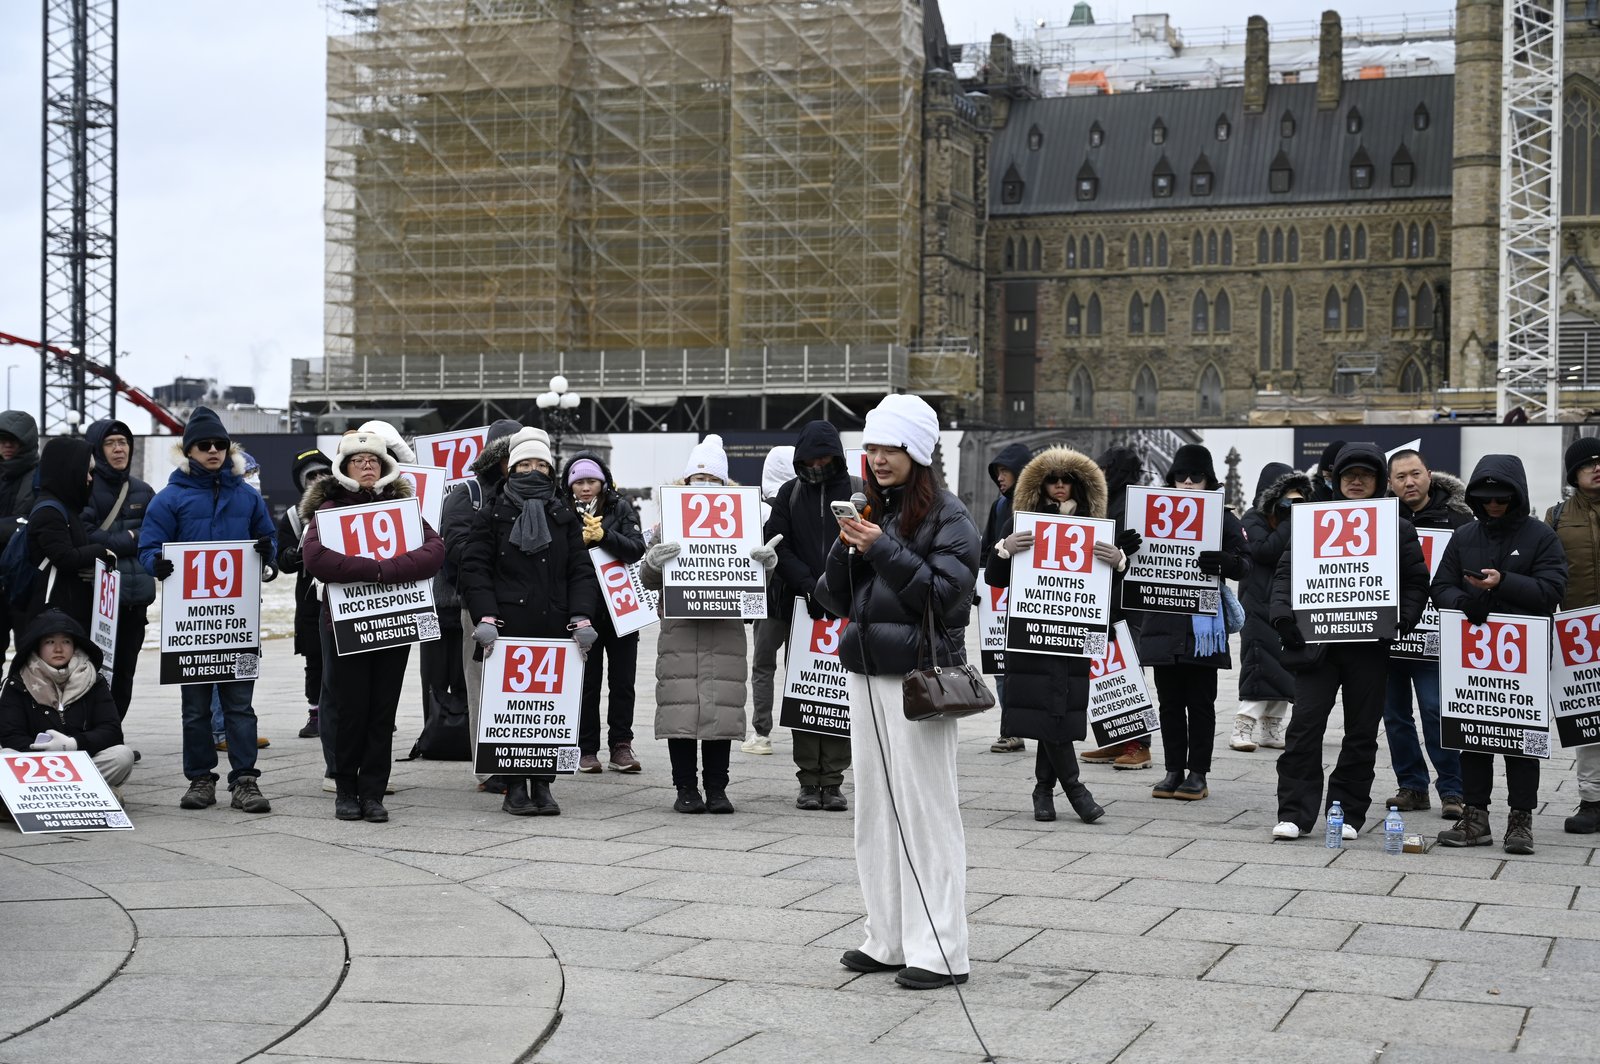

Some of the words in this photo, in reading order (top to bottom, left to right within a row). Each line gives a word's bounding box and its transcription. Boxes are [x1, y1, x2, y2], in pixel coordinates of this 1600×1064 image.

[439, 438, 477, 479] 72
[688, 494, 736, 537] 23
[1151, 496, 1197, 539] 32
[350, 512, 397, 560] 19
[1320, 509, 1369, 556] 23
[690, 544, 737, 554] MONTHS
[1041, 524, 1086, 571] 13
[1150, 544, 1195, 555] MONTHS
[678, 558, 724, 567] WAITING
[729, 558, 750, 567] FOR
[1138, 555, 1182, 567] WAITING
[1186, 559, 1200, 568] FO
[1320, 562, 1369, 574] MONTHS
[192, 551, 234, 598] 19
[671, 571, 695, 580] IRCC
[698, 571, 757, 581] RESPONSE
[1131, 567, 1153, 577] IRCC
[1156, 569, 1212, 582] RESPONSE
[604, 566, 635, 610] 30
[1038, 576, 1085, 589] MONTHS
[1307, 577, 1355, 589] WAITING
[1360, 576, 1382, 587] FOR
[101, 572, 115, 618] 36
[343, 582, 393, 599] WAITING
[683, 591, 696, 599] NO
[698, 591, 746, 599] TIMELINE
[1025, 588, 1071, 602] WAITING
[1075, 592, 1096, 604] FOR
[1140, 586, 1152, 594] NO
[1154, 587, 1200, 597] TIMELINES
[1300, 593, 1324, 604] IRCC
[1327, 590, 1390, 603] RESPONSE
[339, 601, 365, 614] IRCC
[367, 591, 425, 610] RESPONSE
[688, 602, 700, 610] NO
[1143, 596, 1155, 604] NO
[1158, 598, 1195, 607] RESULTS
[188, 605, 234, 617] MONTHS
[1017, 602, 1041, 613] IRCC
[1043, 605, 1101, 619] RESPONSE
[1311, 613, 1324, 622] NO
[1326, 611, 1377, 622] TIMELINES
[176, 619, 222, 632] WAITING
[226, 618, 246, 629] FOR
[354, 621, 367, 632] NO
[369, 614, 417, 629] TIMELINES
[1027, 623, 1039, 632] NO
[1042, 624, 1089, 636] TIMELINES
[1315, 625, 1328, 634] NO
[1331, 623, 1373, 633] RESULTS
[168, 636, 192, 646] IRCC
[195, 632, 252, 645] RESPONSE
[360, 633, 373, 643] NO
[376, 626, 416, 640] RESULTS
[817, 618, 841, 653] 3
[1030, 635, 1042, 644] NO
[1045, 636, 1084, 647] RESULTS
[1402, 633, 1426, 642] LINES
[985, 638, 1003, 646] IRCC
[1391, 643, 1423, 652] ESULTS
[1468, 624, 1520, 672] 36
[179, 656, 192, 665] NO
[814, 660, 848, 673] MONT
[183, 667, 195, 676] NO
[198, 665, 236, 675] RESULTS
[509, 647, 557, 692] 34
[1573, 667, 1600, 681] MON
[800, 671, 846, 686] WAITING
[1096, 675, 1126, 691] MONTHS
[1468, 675, 1520, 690] MONTHS
[791, 683, 815, 695] IRCC
[817, 687, 849, 700] RESP
[1091, 689, 1122, 704] WAITING
[1123, 684, 1137, 695] FOR
[1455, 688, 1505, 703] WAITING
[1510, 694, 1534, 706] FOR
[507, 700, 554, 711] MONTHS
[800, 704, 813, 713] NO
[815, 705, 850, 719] TIMELIN
[1091, 707, 1107, 717] IRCC
[1107, 693, 1146, 712] RESPONSE
[1448, 702, 1474, 714] IRCC
[1477, 705, 1541, 721] RESPONSE
[1560, 698, 1586, 711] IRCC
[494, 714, 540, 724] WAITING
[544, 715, 565, 725] FOR
[802, 715, 815, 724] NO
[818, 717, 850, 729] RESULT
[1103, 721, 1113, 730] NO
[1113, 712, 1143, 726] TIMELINES
[1576, 717, 1589, 727] NO
[486, 728, 510, 738] IRCC
[512, 728, 571, 738] RESPONSE
[1108, 729, 1118, 738] NO
[1118, 722, 1143, 735] RESULTS
[1461, 723, 1474, 732] NO
[1476, 724, 1524, 738] TIMELINE
[1582, 728, 1596, 738] NO
[1465, 735, 1478, 744] NO
[1482, 737, 1524, 749] RESULTS
[495, 747, 508, 756] NO
[511, 748, 557, 756] TIMELINES
[15, 757, 73, 782] 28
[498, 759, 511, 767] NO
[514, 759, 553, 768] RESULTS
[48, 800, 111, 808] RESPONSE
